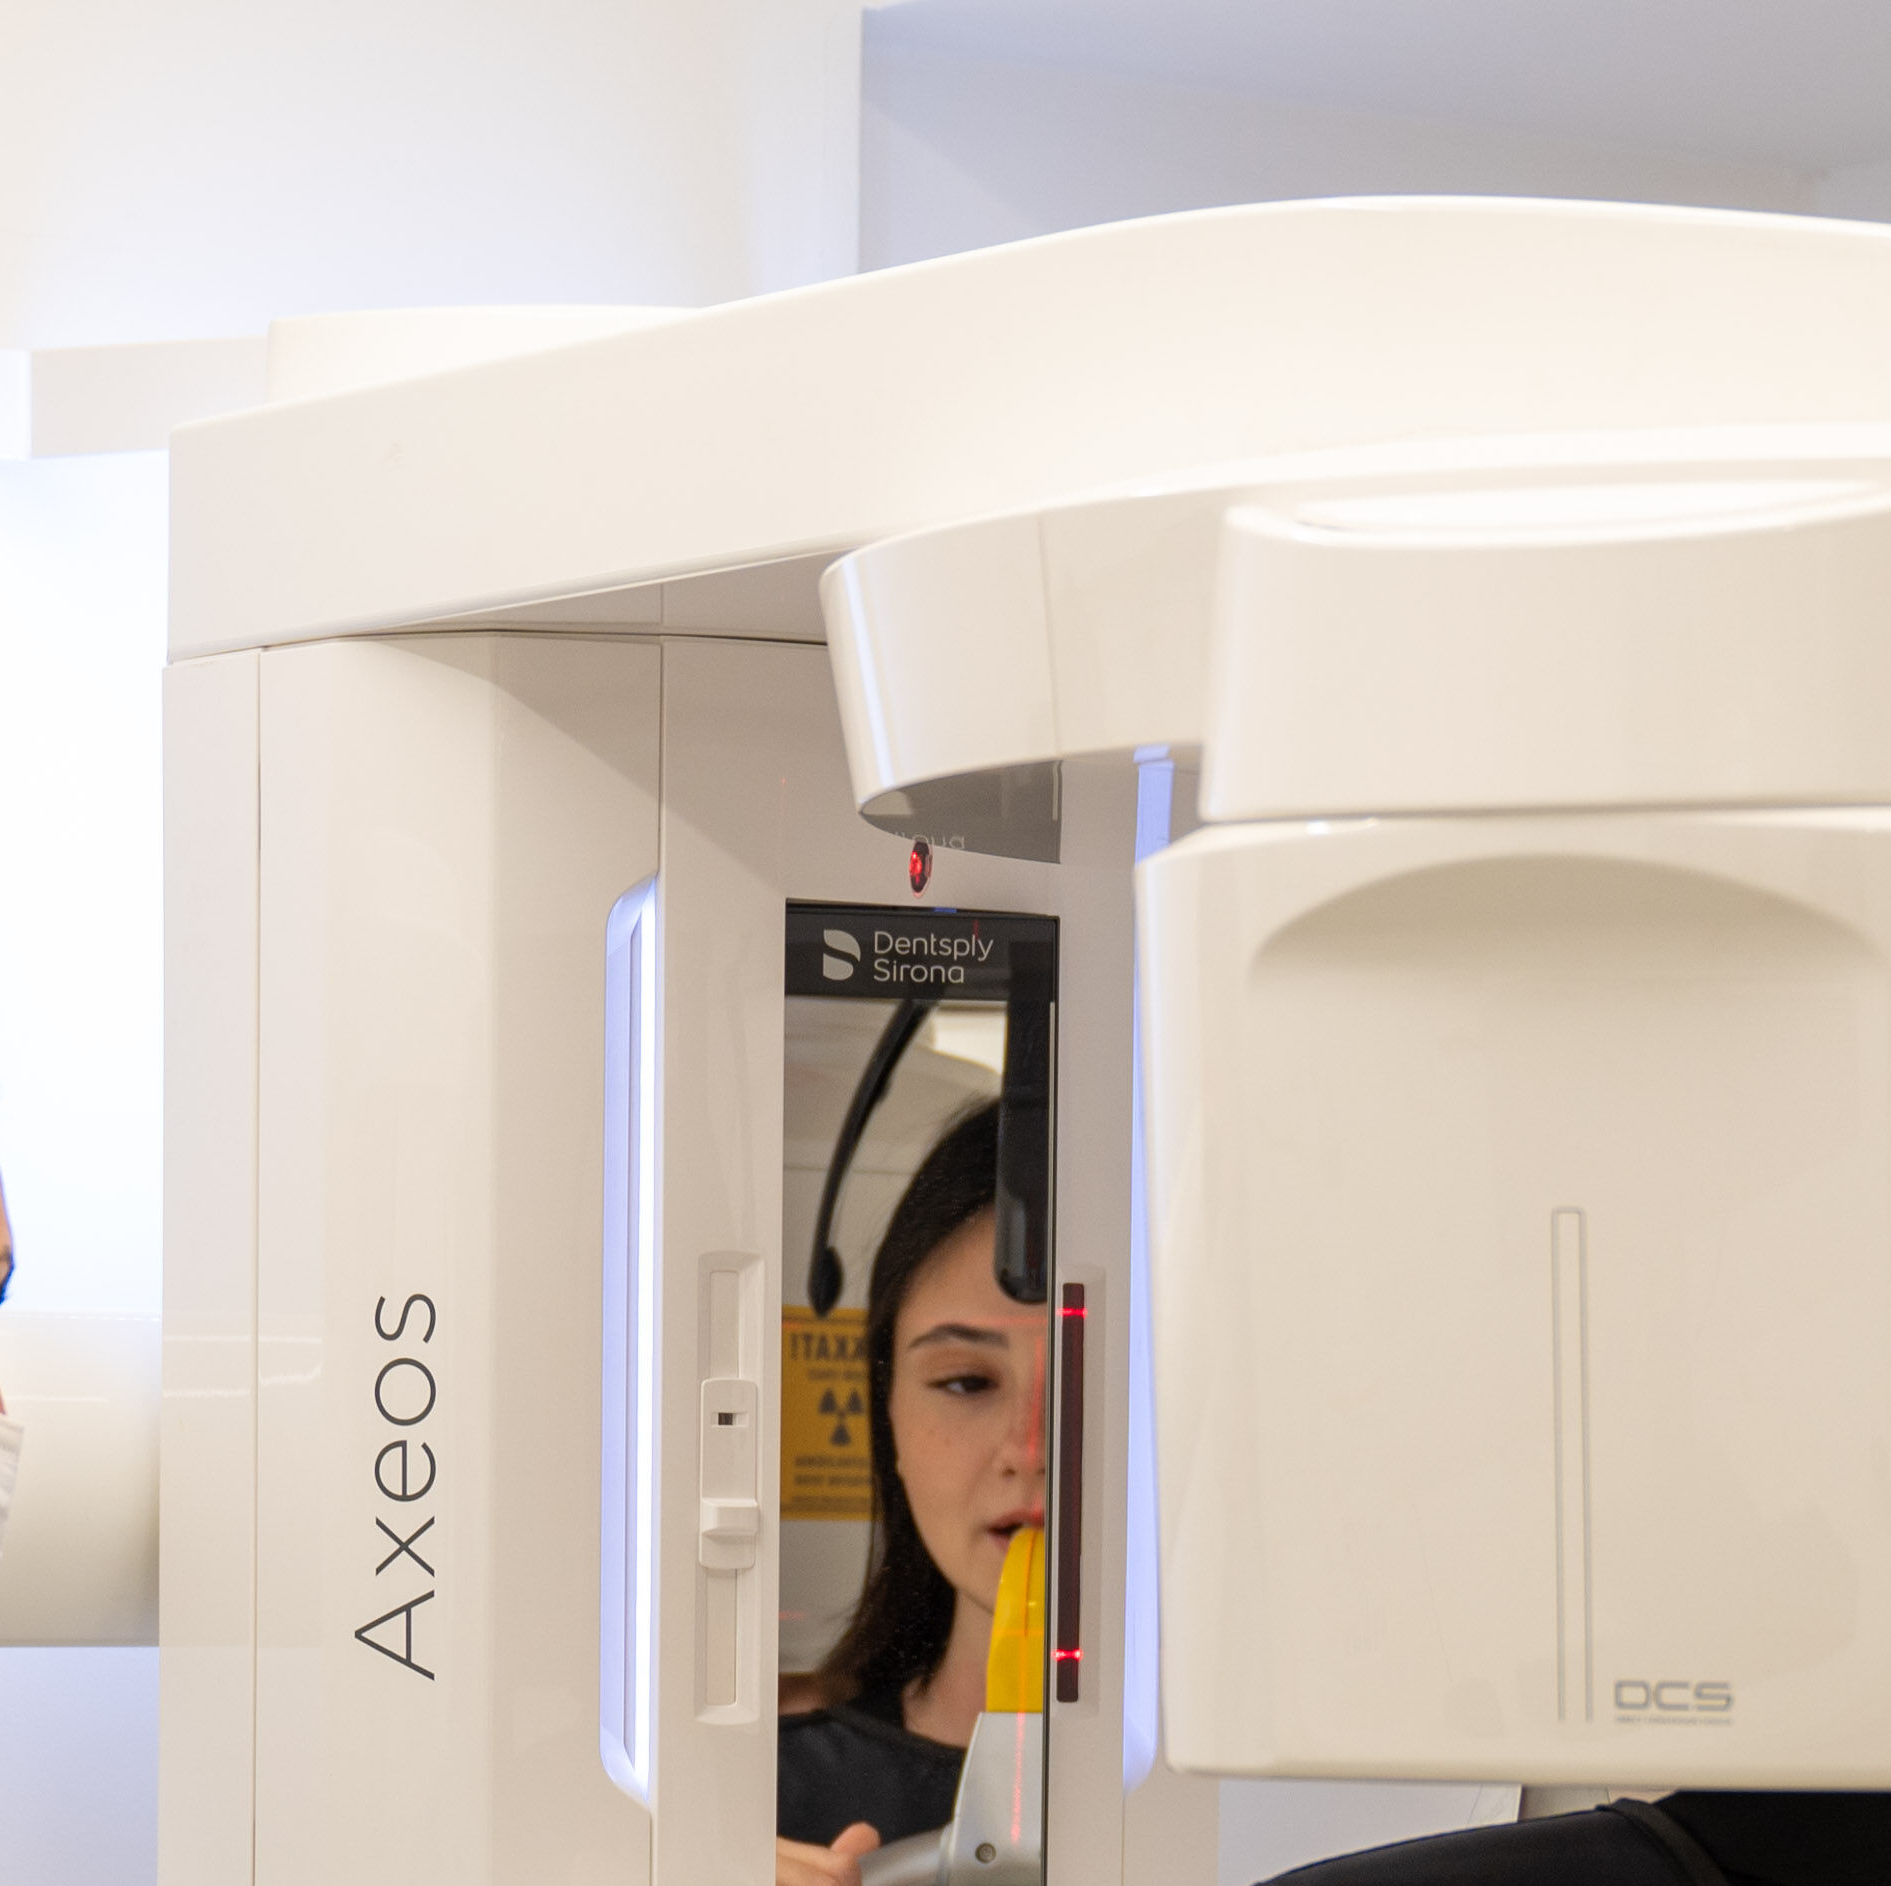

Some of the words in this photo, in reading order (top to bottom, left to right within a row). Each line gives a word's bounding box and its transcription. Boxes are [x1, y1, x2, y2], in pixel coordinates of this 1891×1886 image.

[874, 931, 994, 962] Dentsply
[873, 958, 965, 984] Sirona
[354, 1292, 437, 1682] Axeos
[1614, 1680, 1735, 1711] DCS
